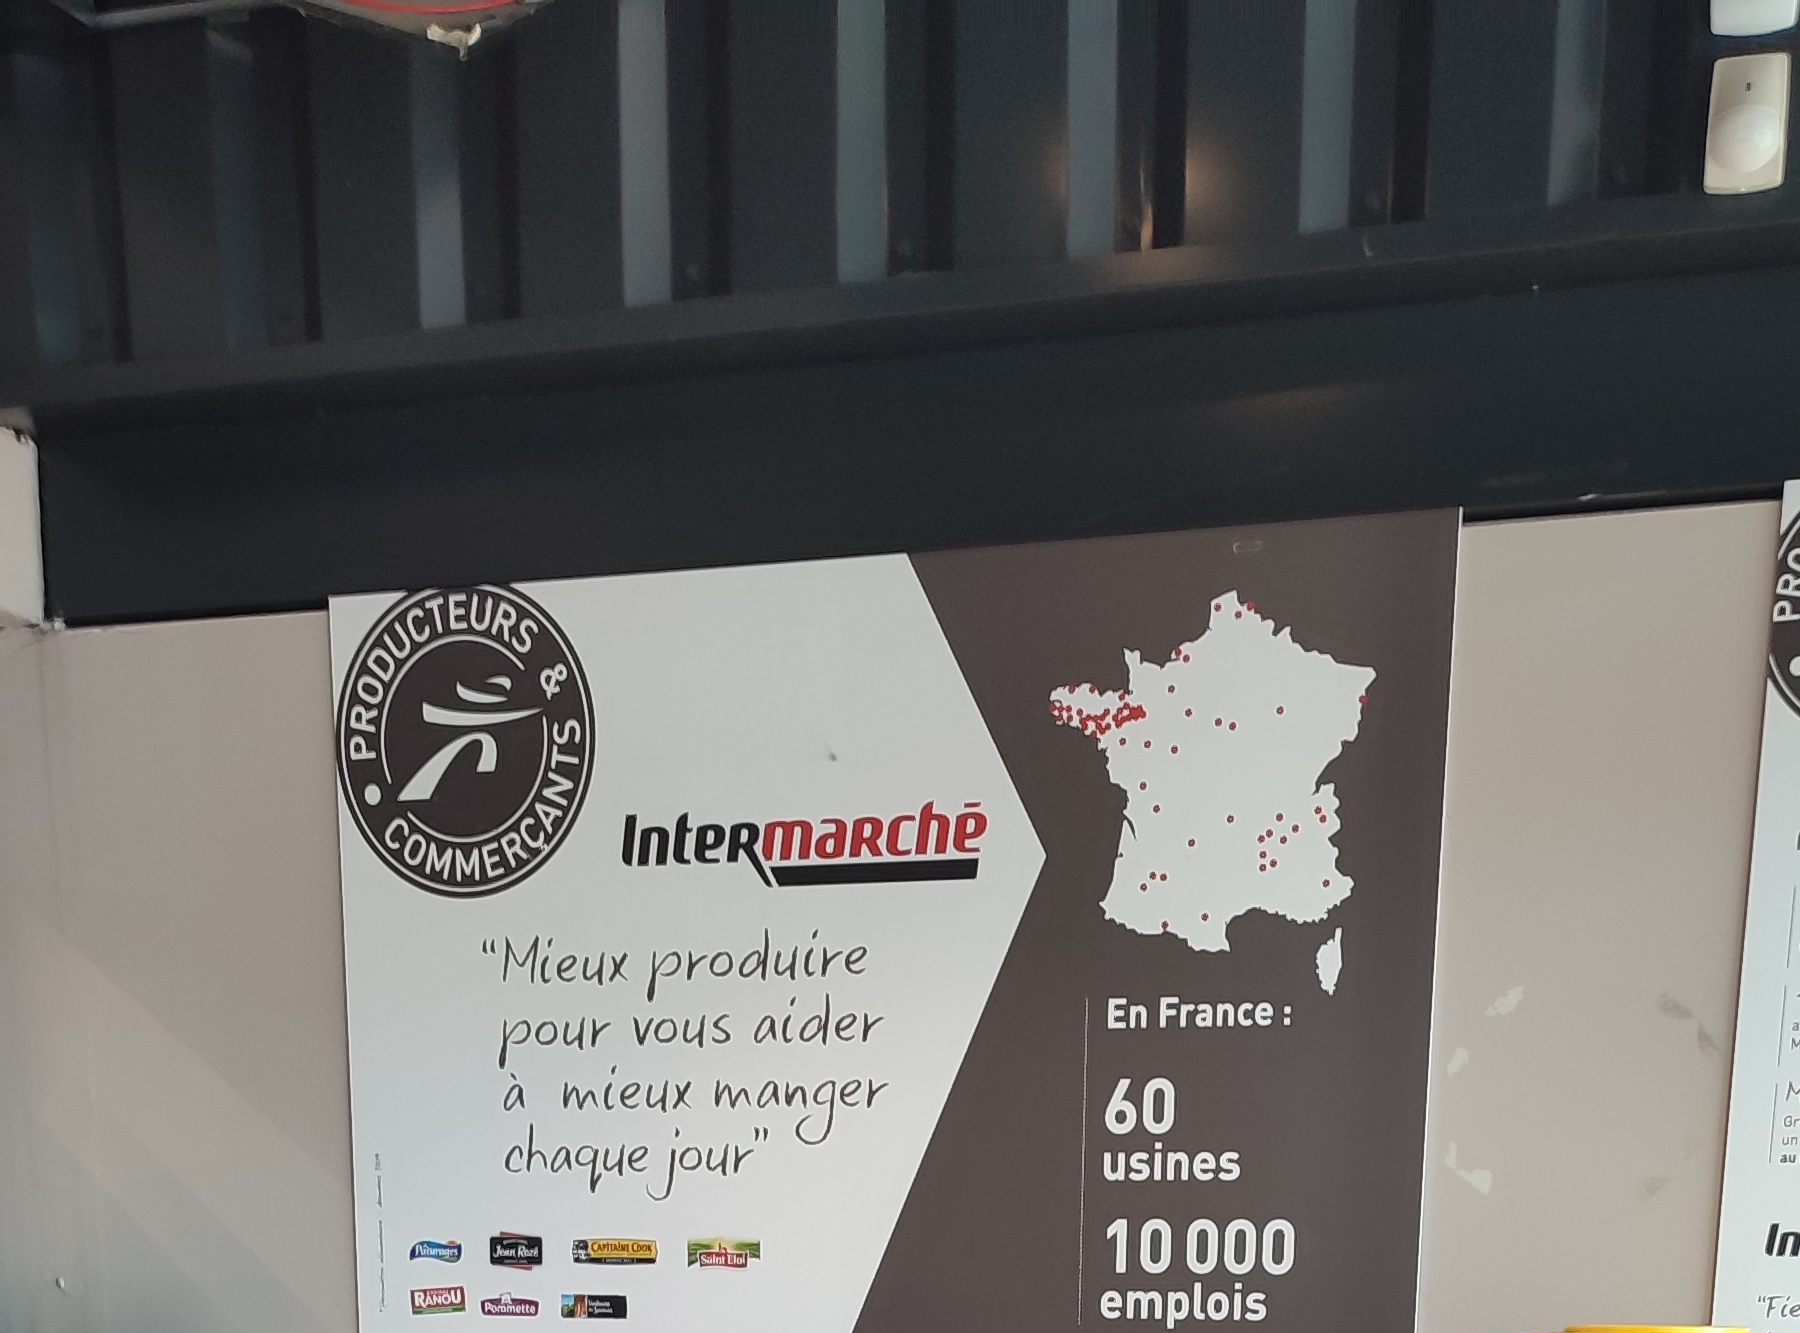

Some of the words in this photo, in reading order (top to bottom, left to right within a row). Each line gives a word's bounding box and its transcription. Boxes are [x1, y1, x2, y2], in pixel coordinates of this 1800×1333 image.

[350, 593, 539, 762] PRODUCTEURS
[539, 662, 568, 700] &
[385, 718, 581, 881] COMMERÇANTS
[622, 800, 988, 888] Intermarché
[647, 928, 868, 1002] produire
[499, 1014, 612, 1069] pour
[633, 1013, 732, 1049] vous
[753, 993, 885, 1045] aider
[1107, 997, 1148, 1029] En
[1158, 996, 1275, 1029] France
[503, 1073, 526, 1112] à
[562, 1064, 693, 1113] mieux
[714, 1076, 889, 1145] manger
[1104, 1077, 1176, 1136] 60
[504, 1123, 648, 1194] chaque
[1103, 1141, 1242, 1182] usines
[1100, 1281, 1269, 1330] emplois
